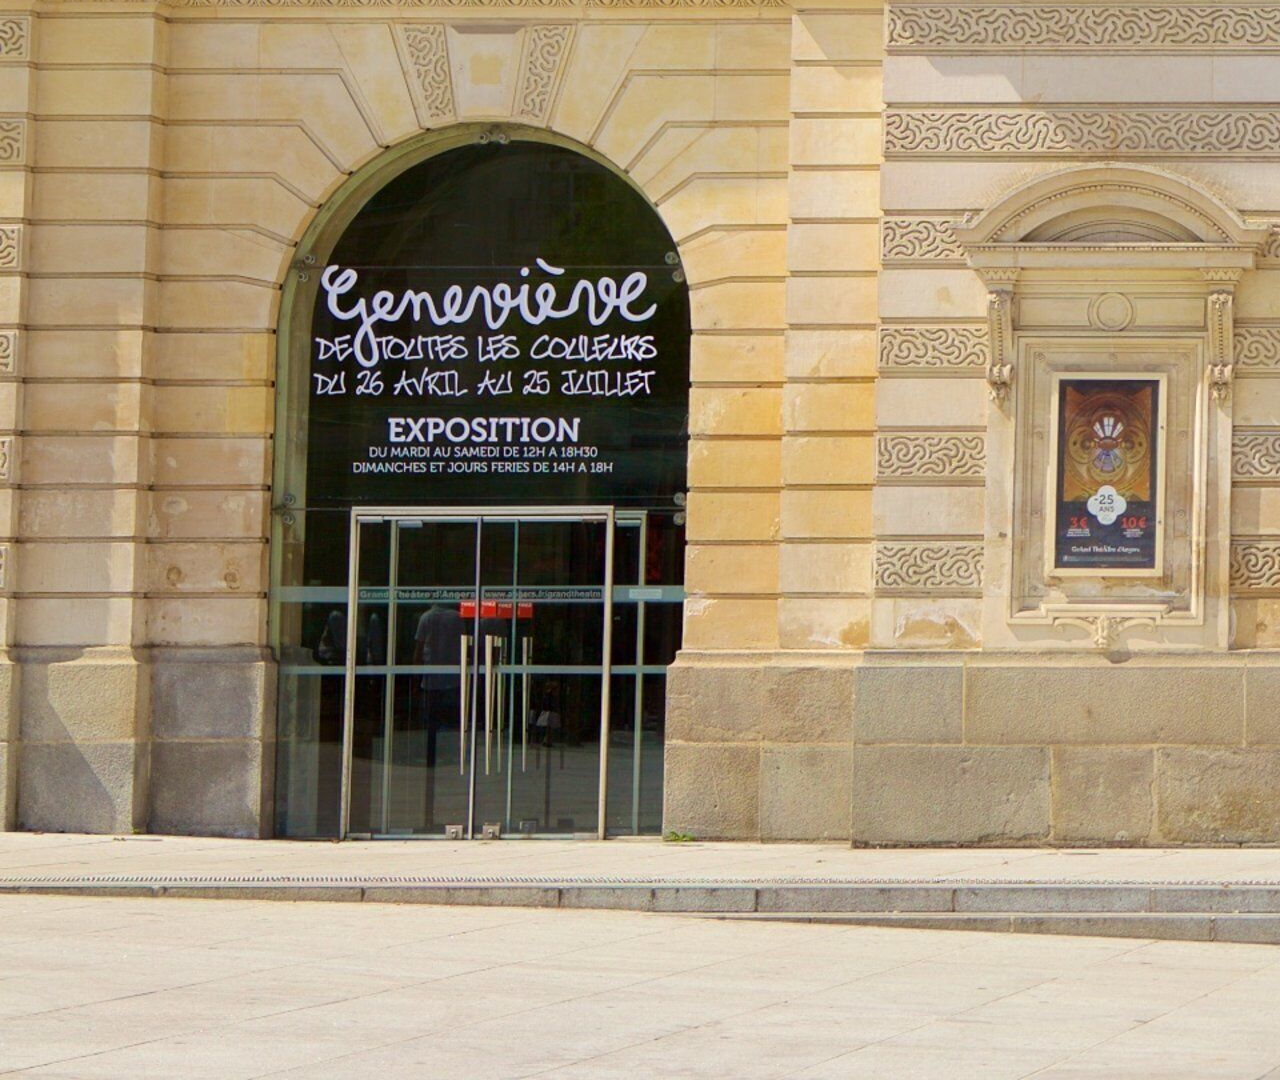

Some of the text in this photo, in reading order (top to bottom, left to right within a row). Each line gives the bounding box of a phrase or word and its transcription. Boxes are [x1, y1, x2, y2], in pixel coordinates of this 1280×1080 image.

[319, 258, 657, 367] Geneviève
[315, 334, 658, 361] DE TOUTES LES COULEURS
[313, 367, 656, 397] DU 26 AVRIL AU 25 JUILLET
[388, 417, 580, 443] EXPOSITION
[369, 446, 598, 458] DU MARDI AU SAMEDI DE 12H A 18H30
[353, 462, 613, 473] DIMANCHES ET JOURS FERIES DE 14H A 18H
[1094, 494, 1114, 505] -25
[360, 591, 390, 599] Grand
